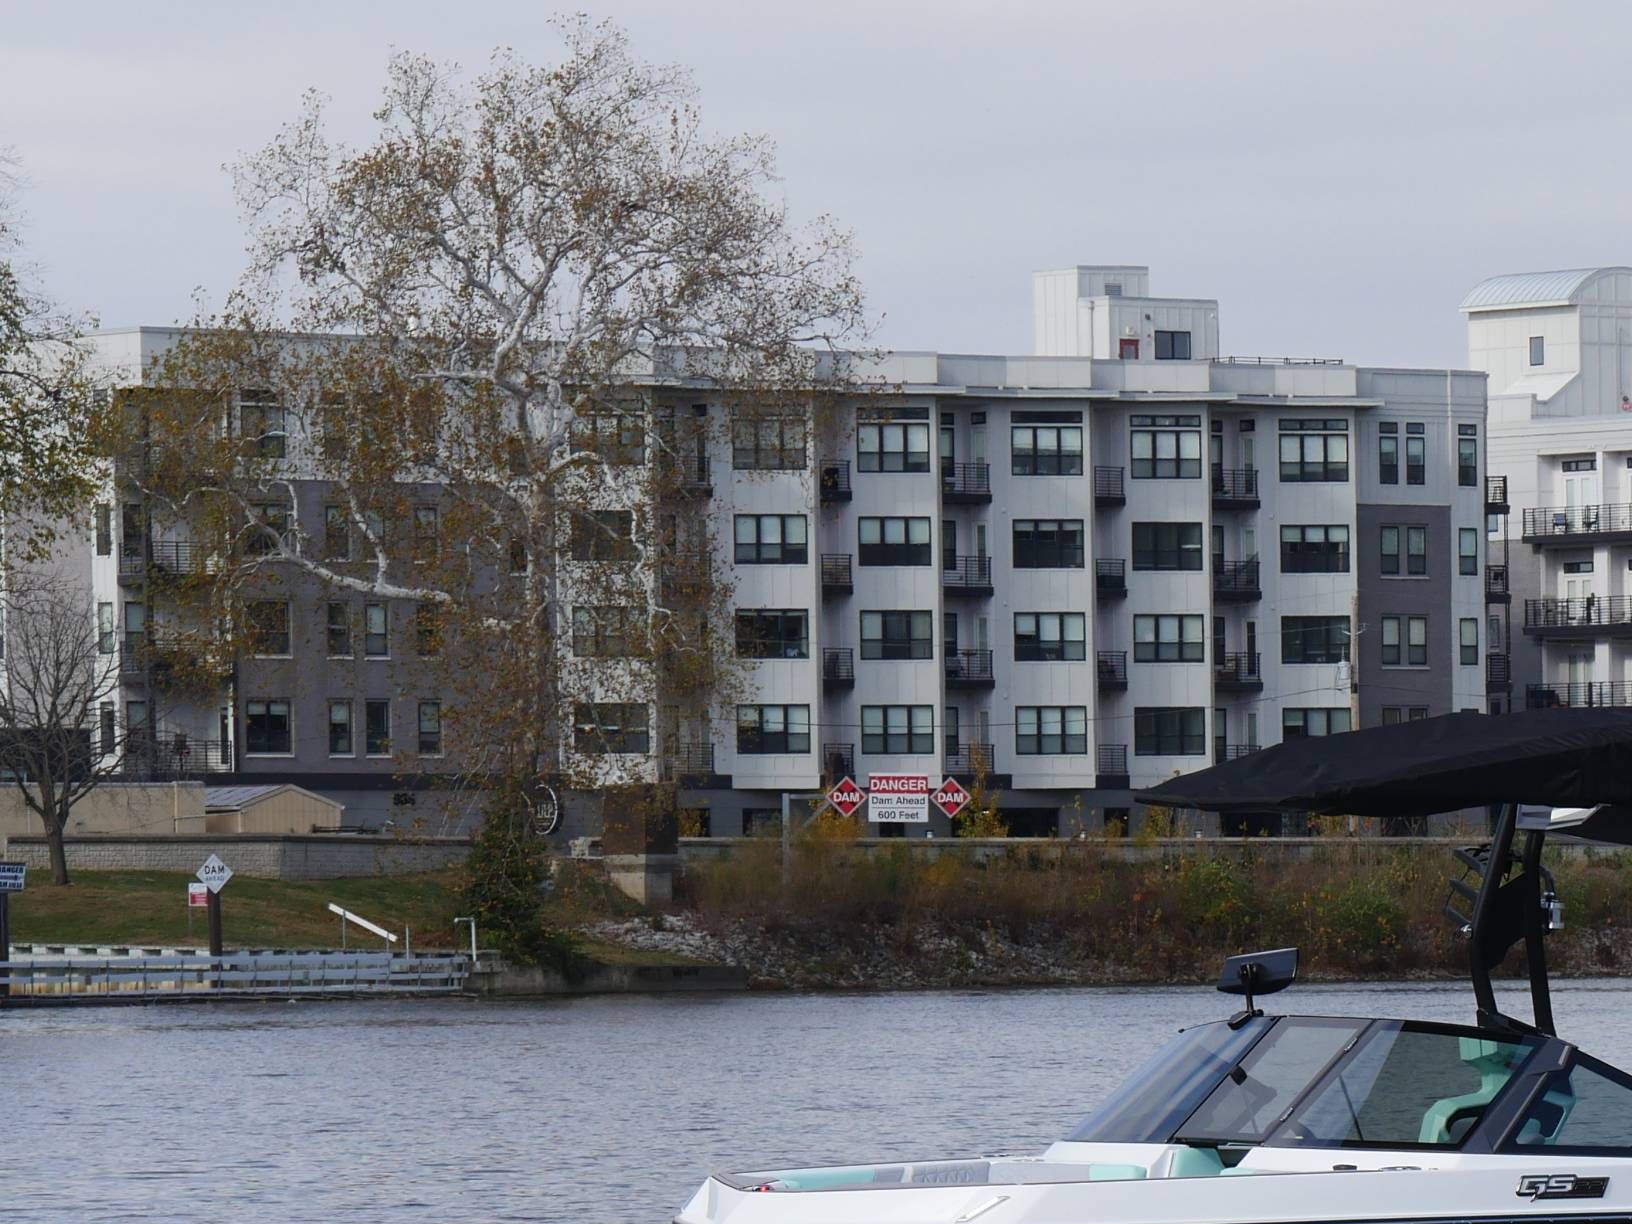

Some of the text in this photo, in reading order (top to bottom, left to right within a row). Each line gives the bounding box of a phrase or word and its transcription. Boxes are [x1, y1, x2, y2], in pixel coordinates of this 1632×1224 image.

[870, 779, 927, 791] DANGER
[833, 792, 860, 802] DAM
[871, 796, 926, 805] Dam Ahead
[937, 792, 964, 803] DAM
[878, 810, 919, 820] 600 Feet
[204, 865, 225, 875] DAM
